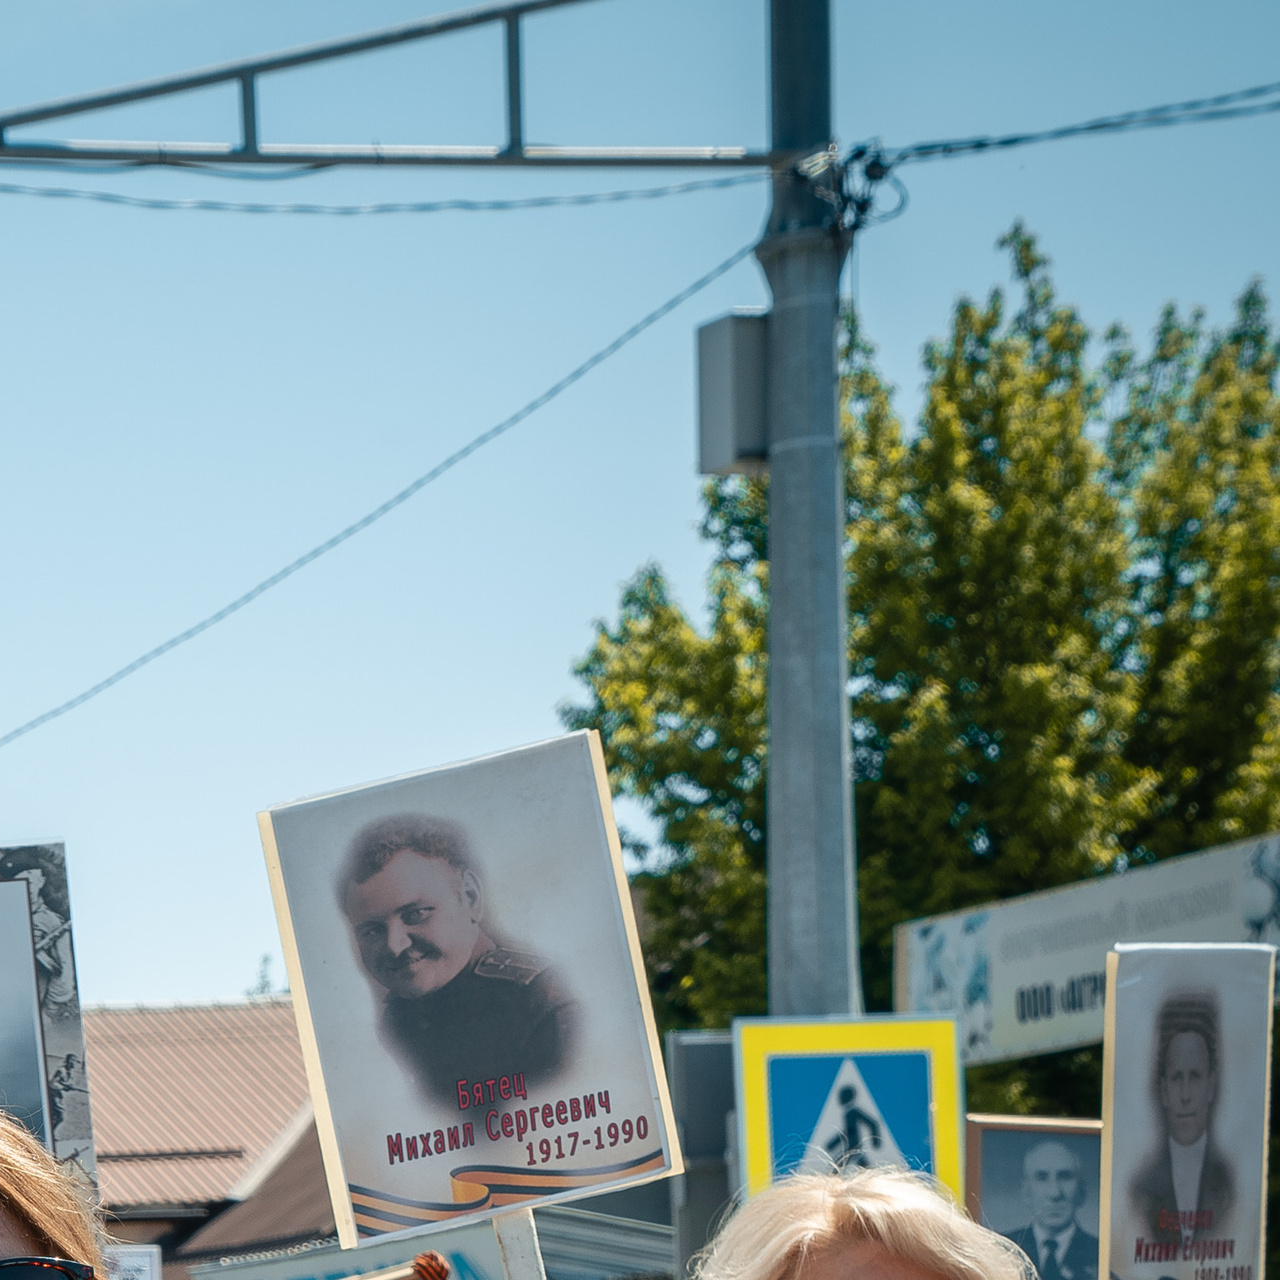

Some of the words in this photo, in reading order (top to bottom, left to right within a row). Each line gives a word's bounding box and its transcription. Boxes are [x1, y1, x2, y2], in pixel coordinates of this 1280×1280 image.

[456, 1072, 527, 1111] Бятец
[386, 1122, 475, 1165] Михаил
[485, 1089, 611, 1143] Сергеевич
[525, 1115, 650, 1166] 1917-1990
